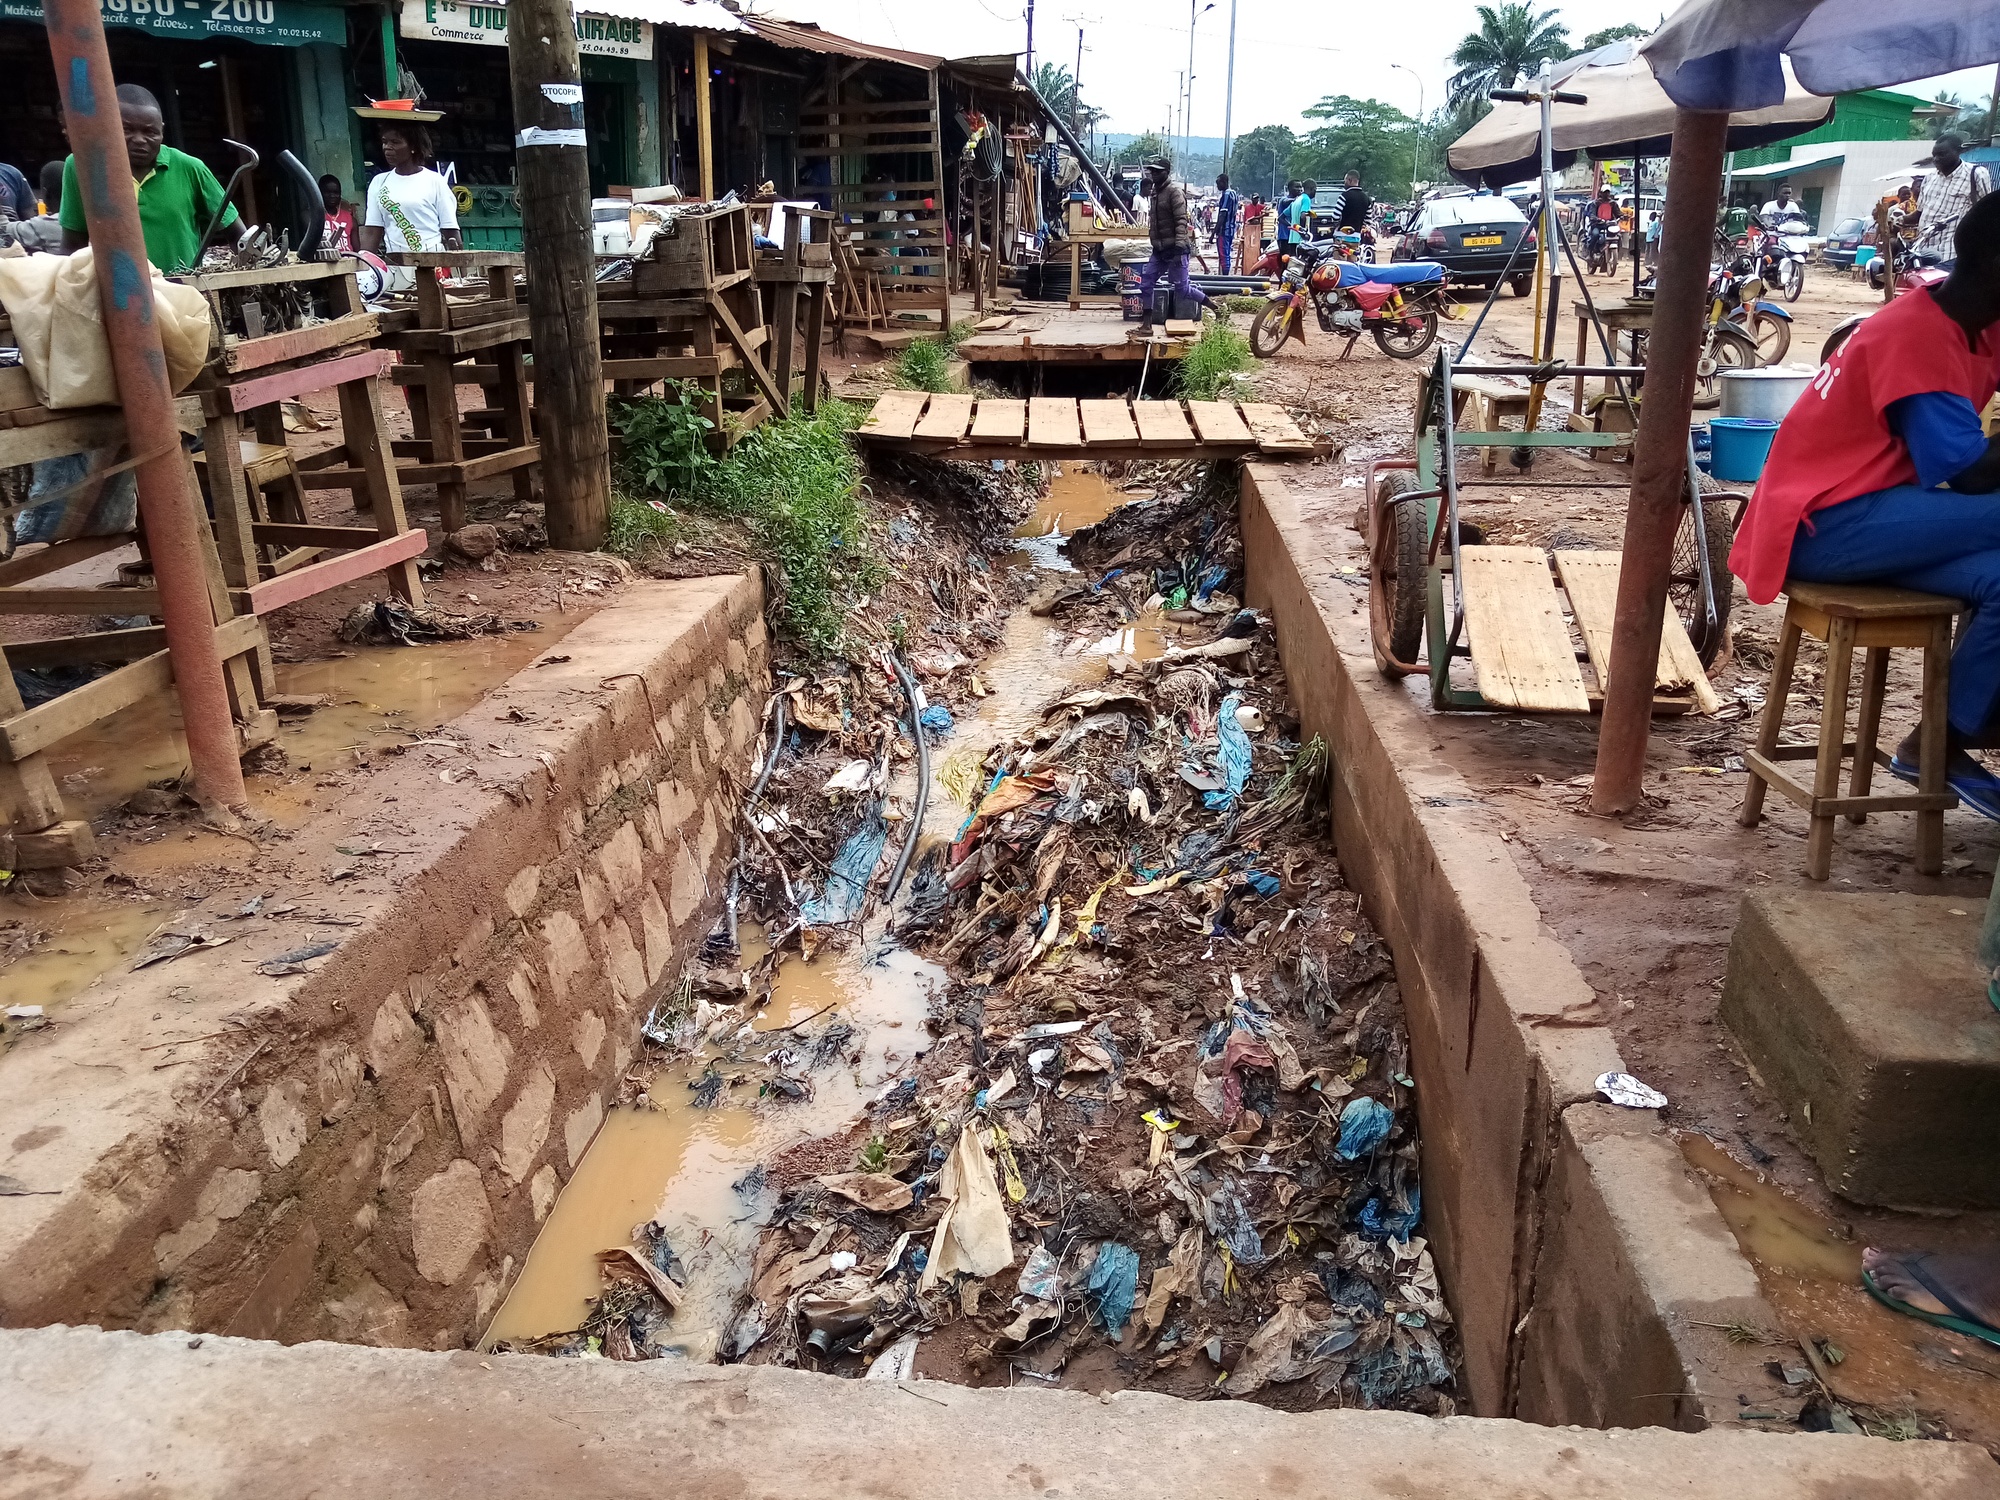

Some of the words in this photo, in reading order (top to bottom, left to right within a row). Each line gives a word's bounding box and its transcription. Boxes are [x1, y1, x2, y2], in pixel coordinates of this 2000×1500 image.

[135, 15, 147, 26] et
[431, 25, 485, 41] Commerce
[541, 86, 578, 96] OTOCOPIE
